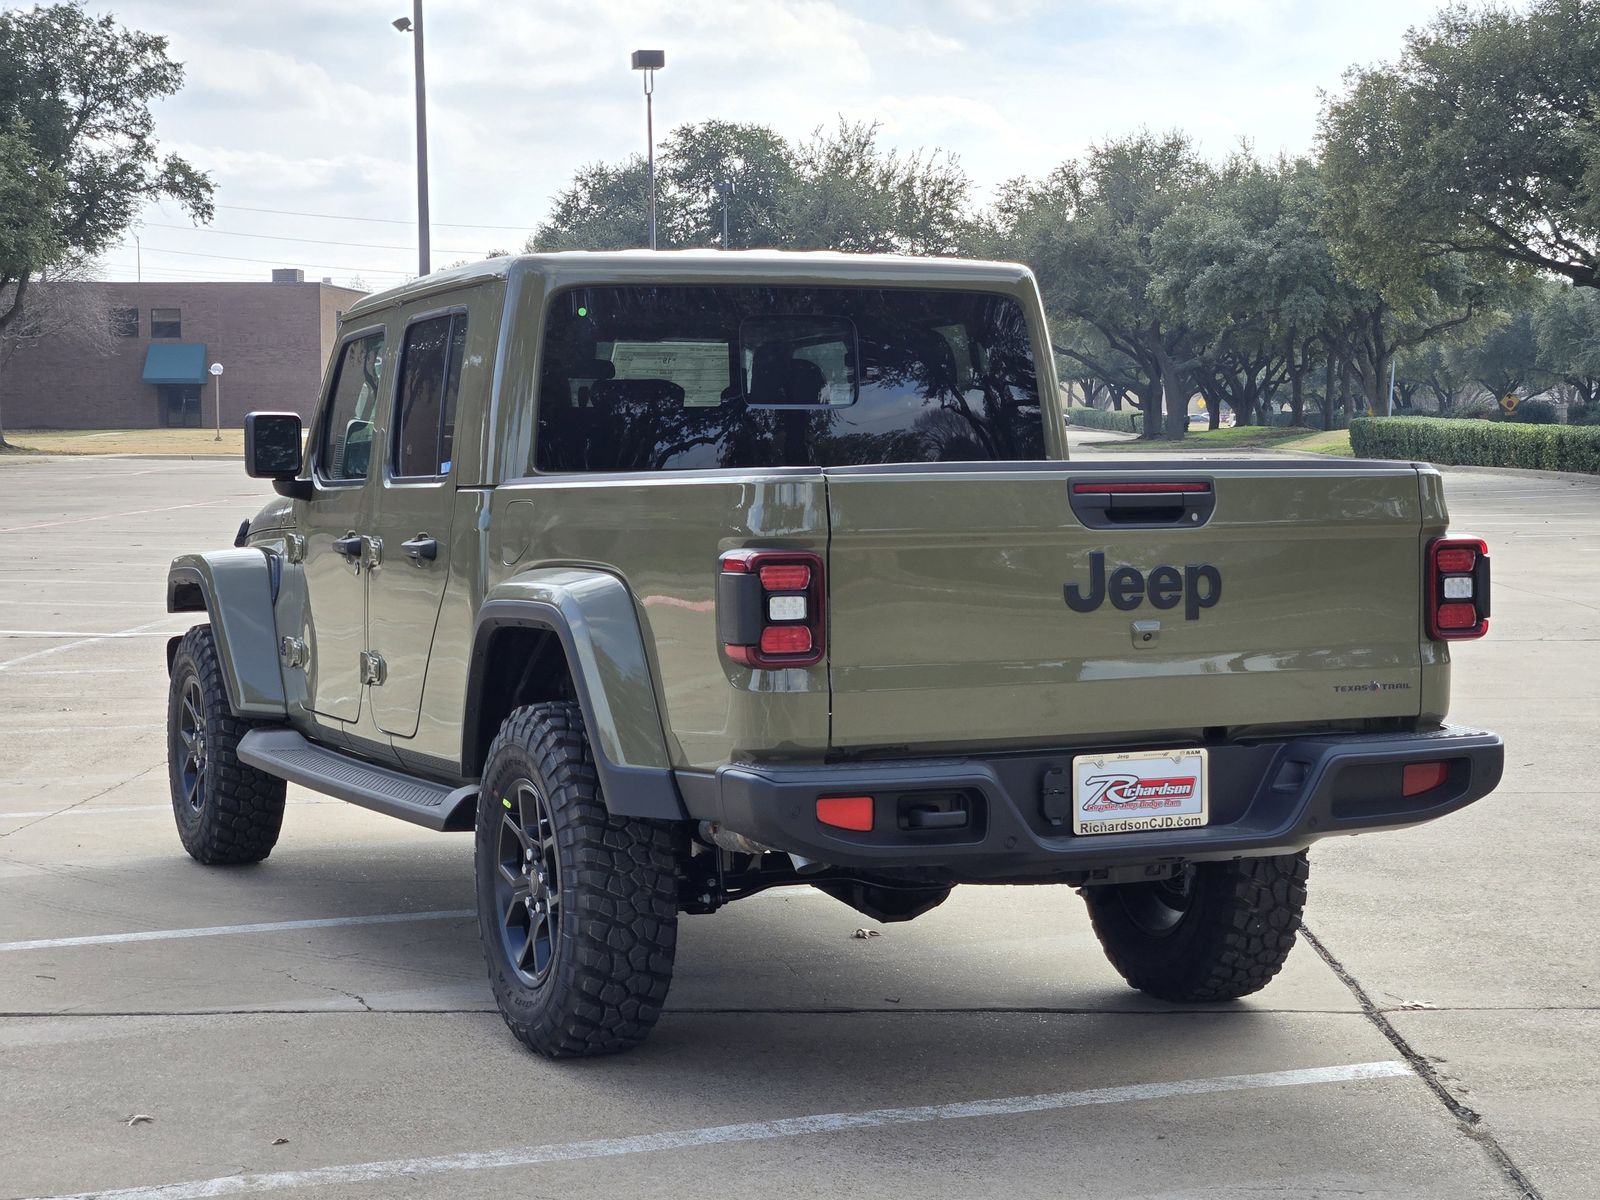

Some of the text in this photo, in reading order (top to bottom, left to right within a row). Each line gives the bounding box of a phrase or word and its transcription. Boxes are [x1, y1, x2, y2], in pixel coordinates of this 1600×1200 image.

[1063, 550, 1222, 620] Jeep
[1334, 684, 1367, 692] TEXAS
[1082, 773, 1191, 811] Richardson
[1079, 816, 1202, 834] RichardsonCJD.com
